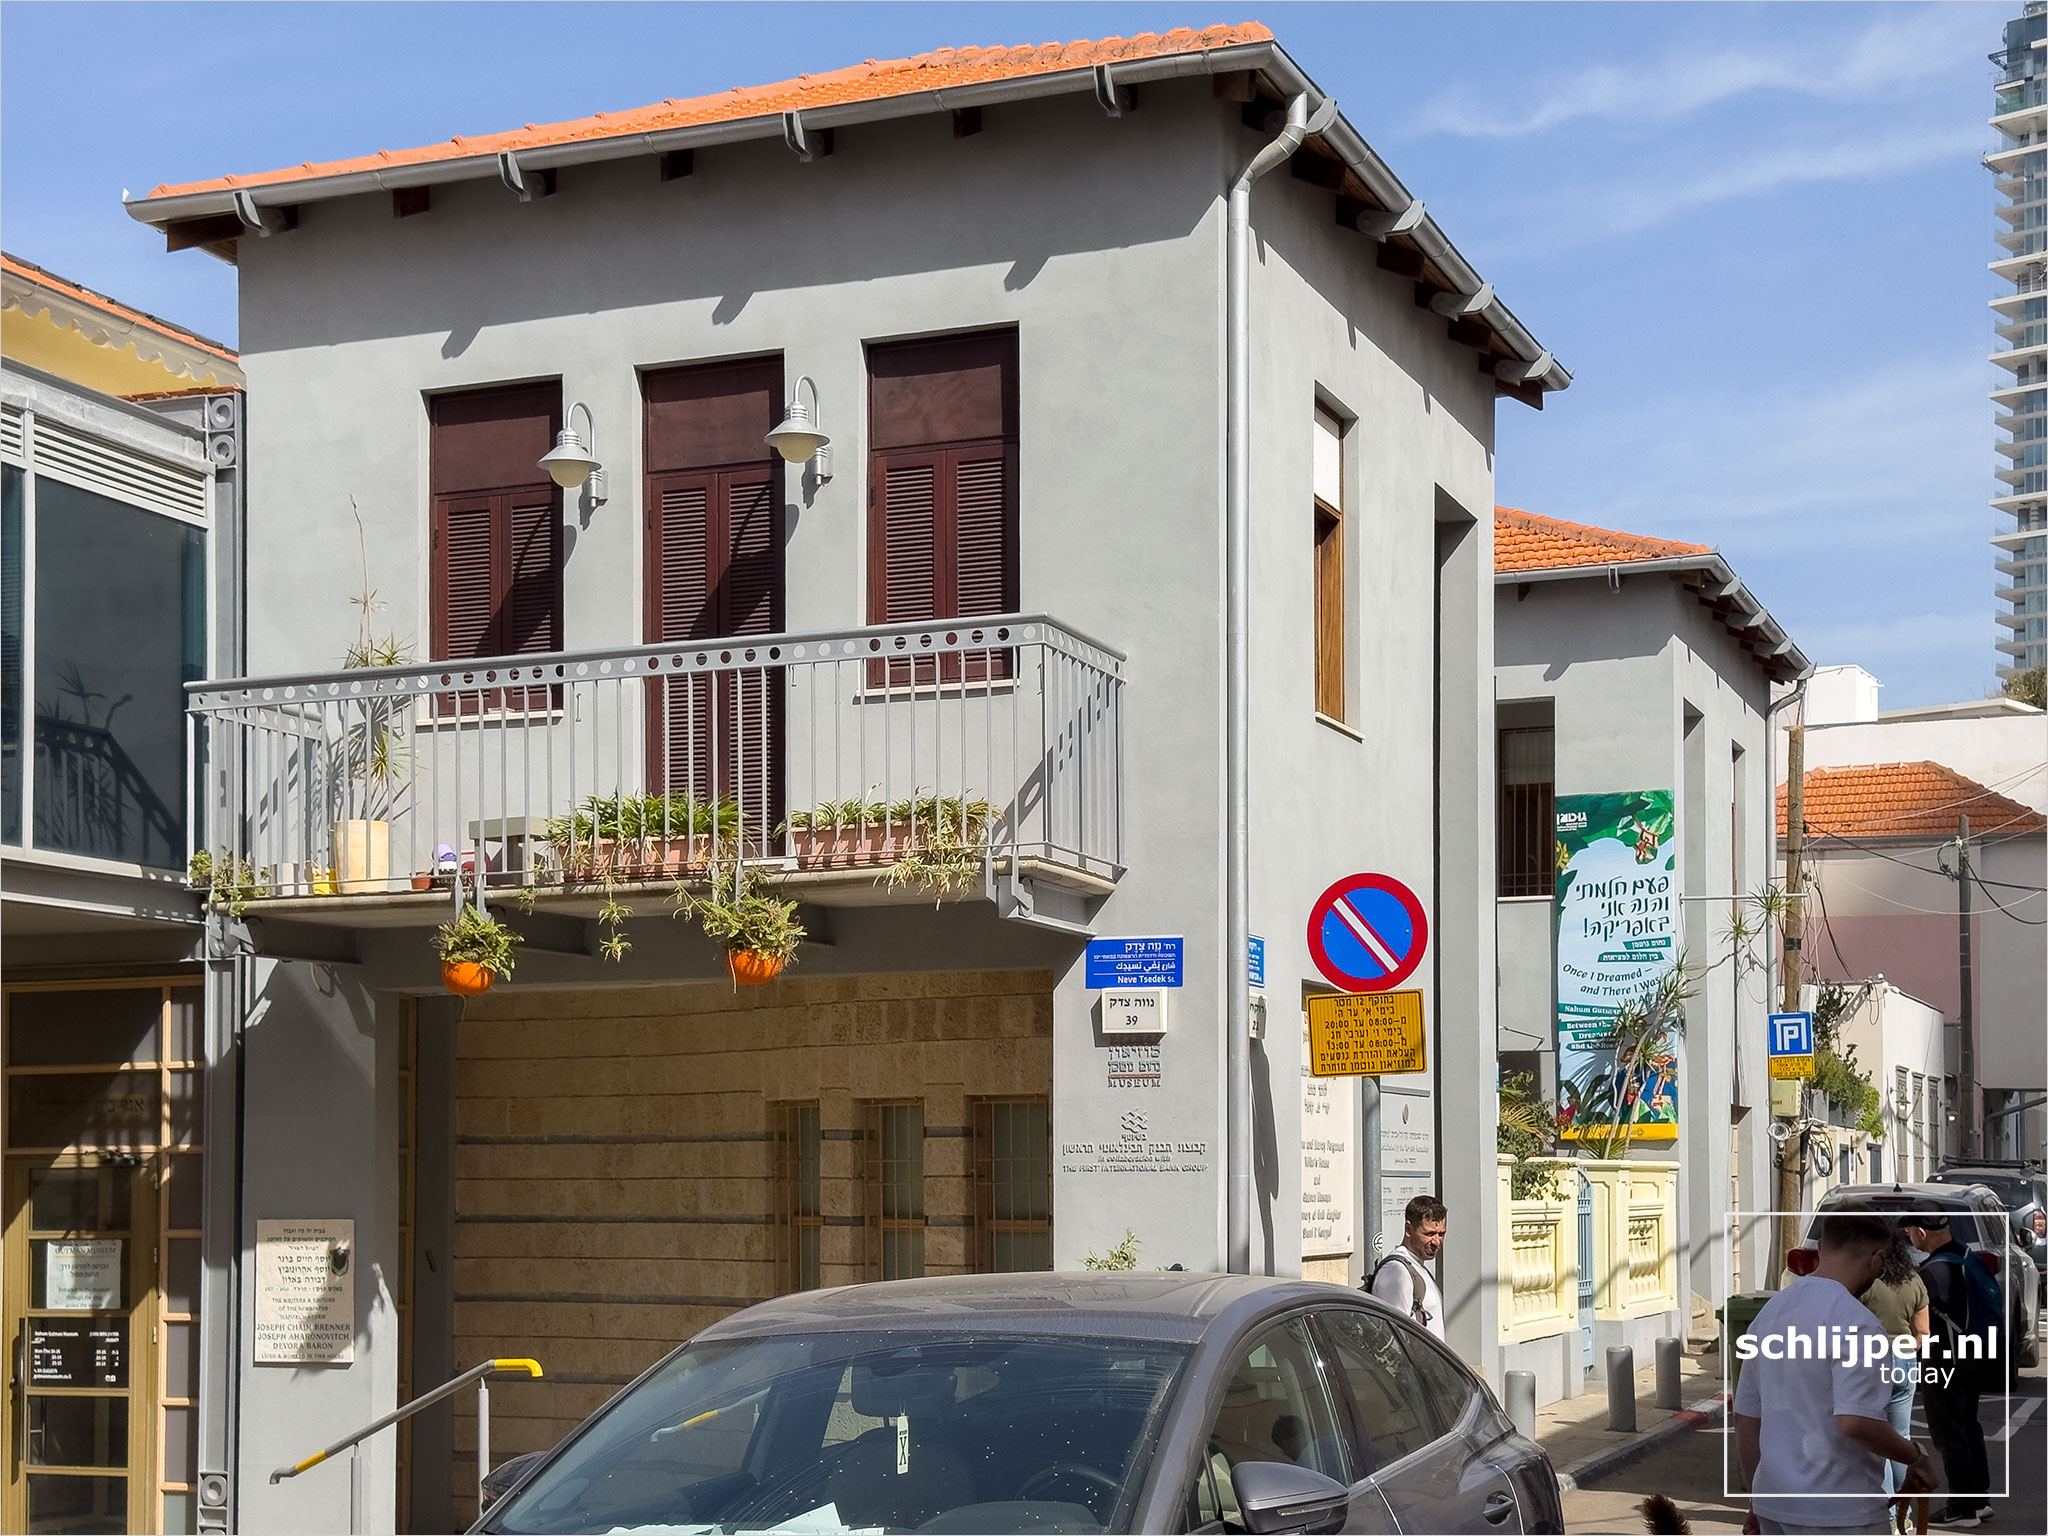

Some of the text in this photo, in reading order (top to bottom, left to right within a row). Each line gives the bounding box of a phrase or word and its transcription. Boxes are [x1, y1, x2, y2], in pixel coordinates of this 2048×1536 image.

[1576, 875, 1669, 901] פעם חלמתי
[1601, 896, 1669, 919] והנה אני
[1563, 964, 1642, 982] Once I Dreamed
[1139, 975, 1166, 983] Tsedek
[1580, 985, 1600, 996] and
[1602, 986, 1631, 996] There
[1639, 976, 1660, 991] Was
[1109, 998, 1155, 1009] נווה צדק
[1334, 995, 1394, 1007] בתוקף 12 מטר
[1347, 1008, 1358, 1017] עד
[1376, 1006, 1394, 1015] בימי
[1564, 1005, 1590, 1013] Nahum
[1125, 1015, 1138, 1025] 39
[1325, 1020, 1350, 1029] 20:00
[1353, 1019, 1364, 1027] עד
[1566, 1022, 1597, 1030] Between
[1331, 1030, 1341, 1039] חג
[1345, 1029, 1369, 1038] וערבי
[1384, 1027, 1402, 1036] בימי
[1327, 1041, 1350, 1050] 13:00
[1320, 1048, 1416, 1062] העלאת והורדת נוסעים
[1321, 1062, 1346, 1072] מותרת
[1350, 1061, 1375, 1071] גוטמן
[1380, 1058, 1416, 1070] למוזיאון
[1108, 1079, 1161, 1088] MUSEUM
[257, 1323, 351, 1331] JOSEPH CHAIM BRENNER
[273, 1342, 333, 1350] DEVORA BARON
